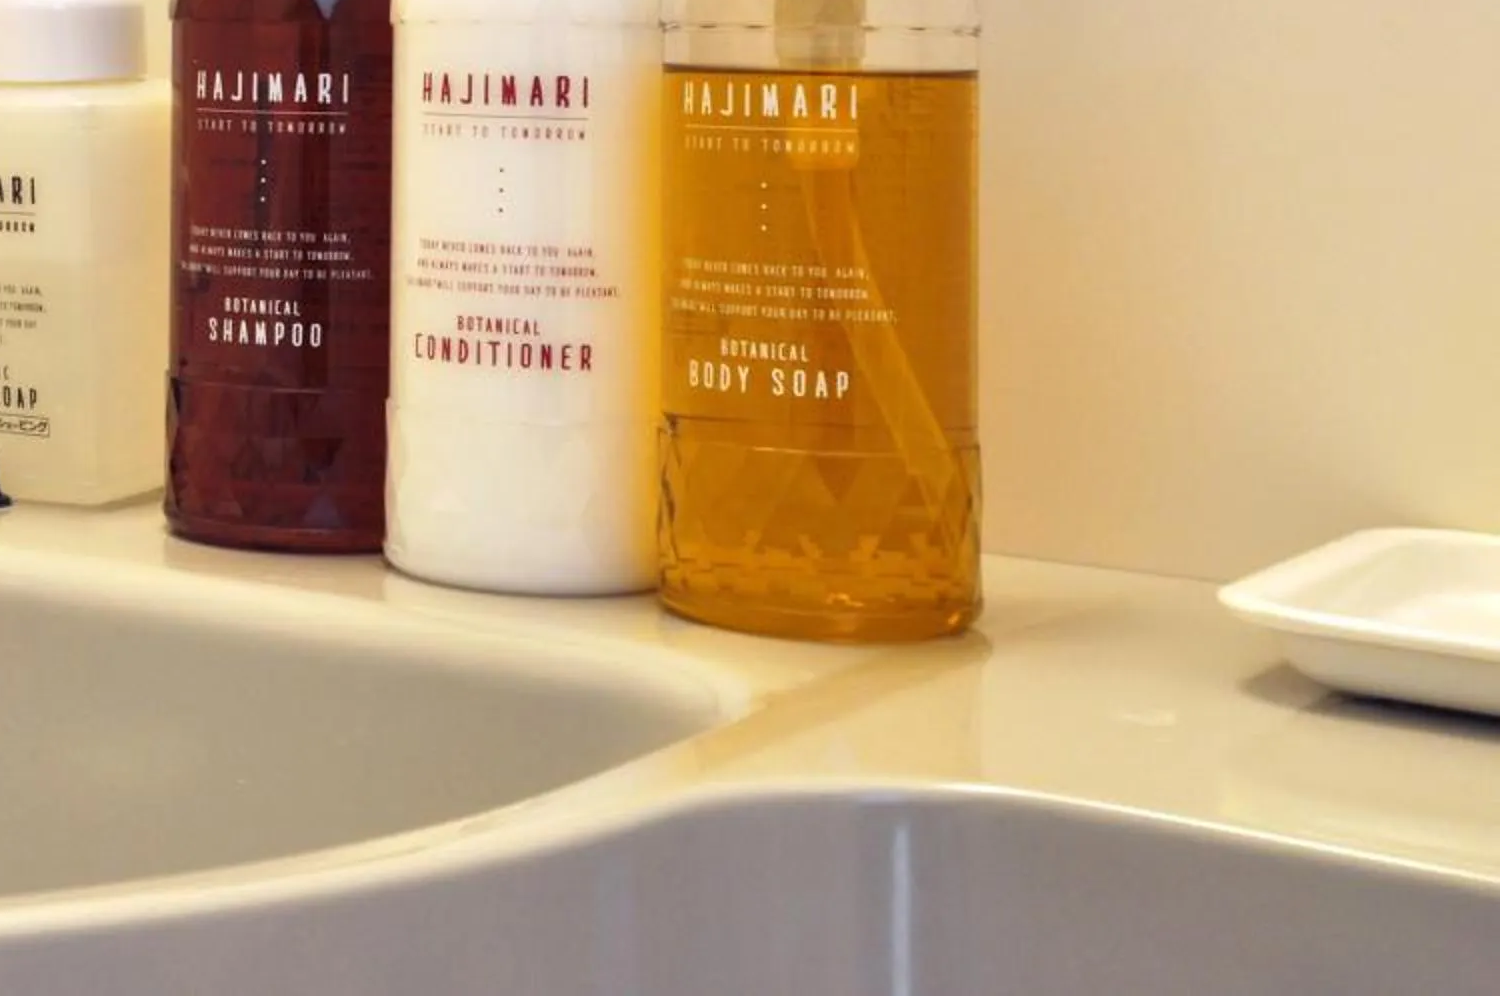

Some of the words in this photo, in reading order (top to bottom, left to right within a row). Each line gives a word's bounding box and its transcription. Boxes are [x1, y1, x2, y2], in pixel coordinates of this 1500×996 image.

[197, 70, 348, 104] HAJIMARI
[422, 72, 589, 108] HAJIMARI
[684, 80, 857, 120] HAJIMARI
[198, 119, 231, 131] START
[242, 120, 256, 133] TO
[268, 121, 346, 135] TOMORROW
[422, 123, 461, 136] START
[472, 125, 489, 138] TO
[500, 125, 585, 140] TOMORROW
[684, 135, 723, 150] START
[733, 137, 749, 152] TO
[761, 138, 855, 154] TOMORROW
[224, 297, 301, 316] BOTANICAL
[209, 317, 322, 348] SHAMPOO
[457, 315, 541, 336] BOTANICAL
[415, 333, 592, 371] CONDITIONER
[720, 337, 809, 362] BOTANICAL
[689, 358, 749, 394] BODY
[772, 367, 849, 400] SOAP
